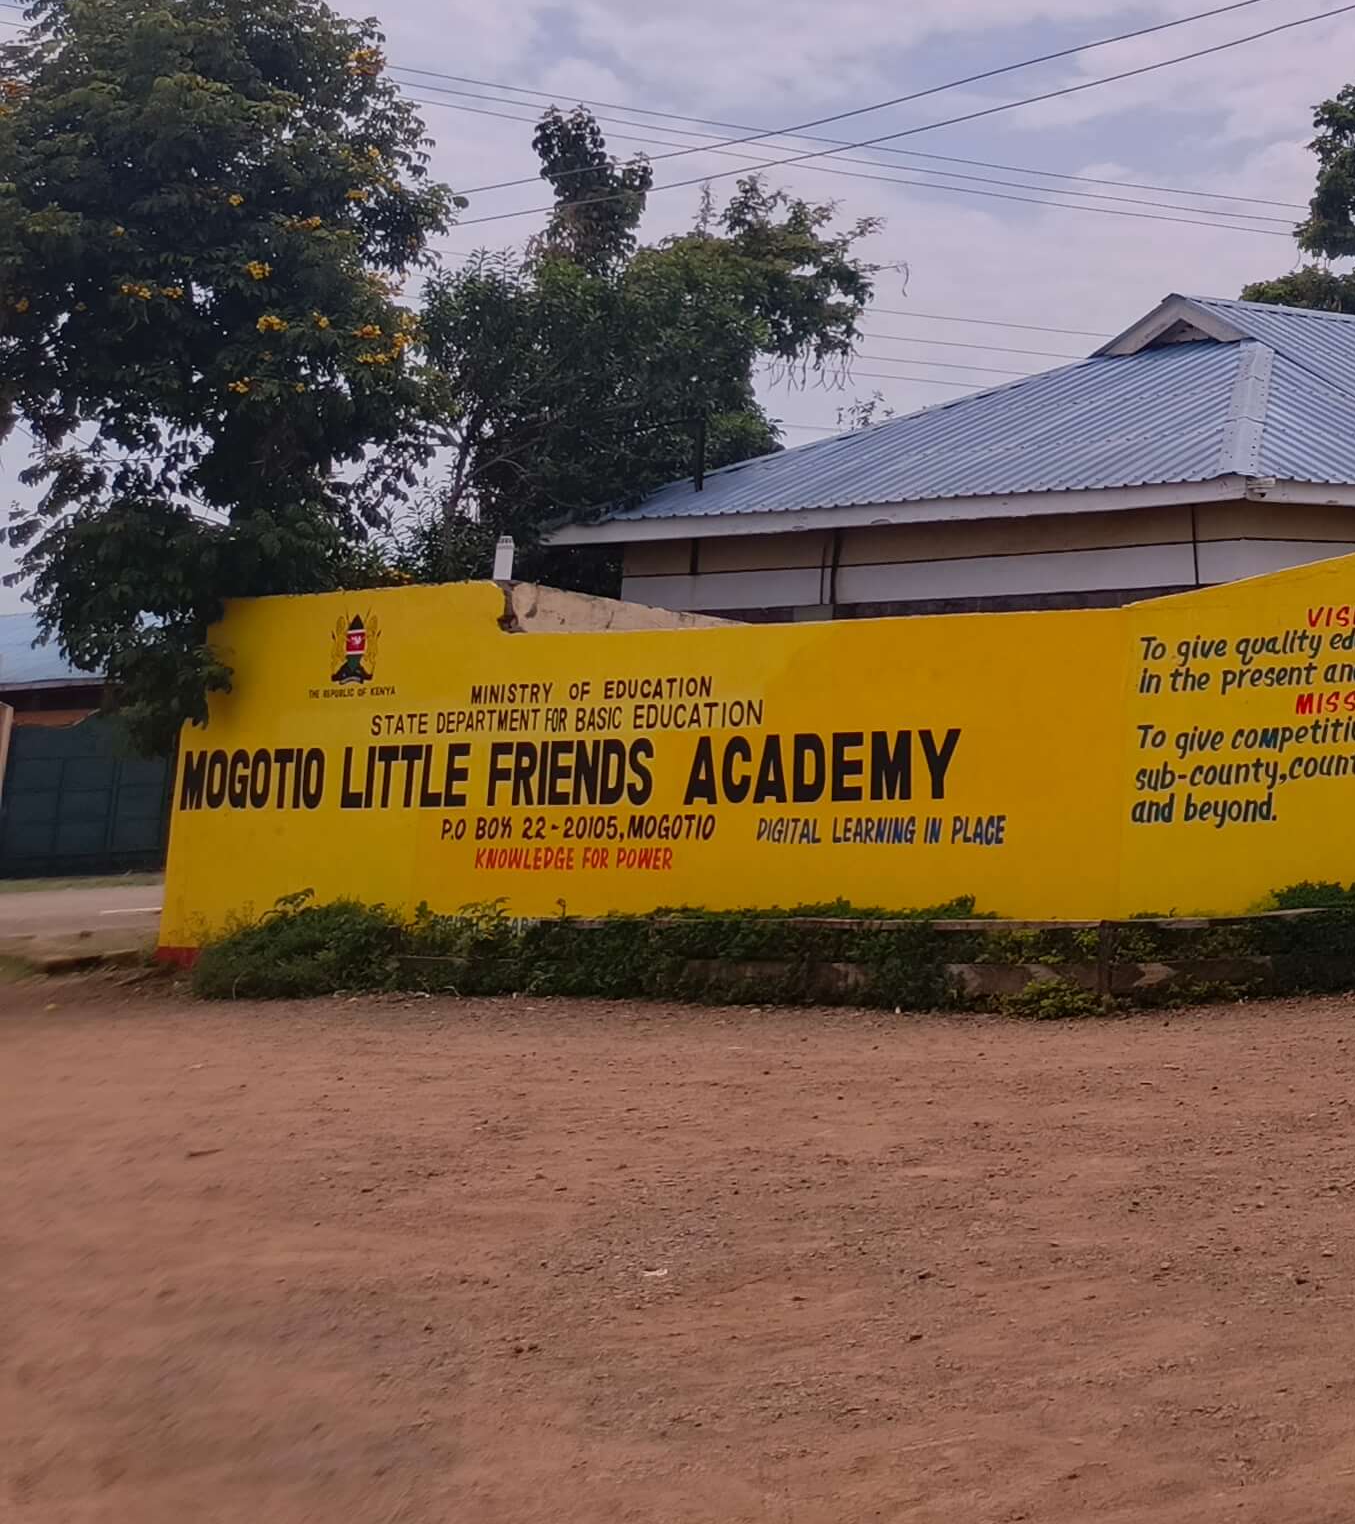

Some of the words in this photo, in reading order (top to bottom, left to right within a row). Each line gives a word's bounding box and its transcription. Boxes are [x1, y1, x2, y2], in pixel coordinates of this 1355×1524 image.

[1140, 636, 1166, 661] To
[1177, 635, 1227, 667] give
[1235, 629, 1322, 666] quality
[309, 690, 319, 699] THE
[323, 688, 354, 698] REPUBLIC
[358, 688, 367, 696] OF
[370, 686, 396, 696] KENYA
[471, 683, 552, 704] MINISTRY
[569, 682, 591, 701] OF
[604, 676, 712, 700] EDUCATION
[1139, 668, 1162, 694] in
[1170, 667, 1210, 692] the
[1221, 662, 1318, 696] present
[371, 713, 428, 736] STATE
[437, 708, 540, 733] DEPARTMENT
[546, 708, 567, 732] FOR
[575, 706, 622, 732] BASIC
[633, 699, 763, 729] EDUCATION
[1137, 725, 1166, 749] To
[1175, 726, 1224, 760] give
[179, 747, 325, 811] MOGOTIO
[340, 743, 471, 808] LITTLE
[486, 737, 654, 806] FRIENDS
[683, 728, 961, 805] ACADEMY
[1131, 793, 1175, 823] and
[1183, 792, 1277, 828] beyond.
[475, 816, 512, 840] BOX
[757, 817, 821, 843] DIGITAL
[832, 816, 916, 844] LEARNING
[924, 818, 942, 844] IN
[951, 815, 1006, 845] PLACE
[475, 847, 574, 870] KNOWLEDGE
[582, 847, 609, 869] FOR
[616, 847, 672, 870] POWER
